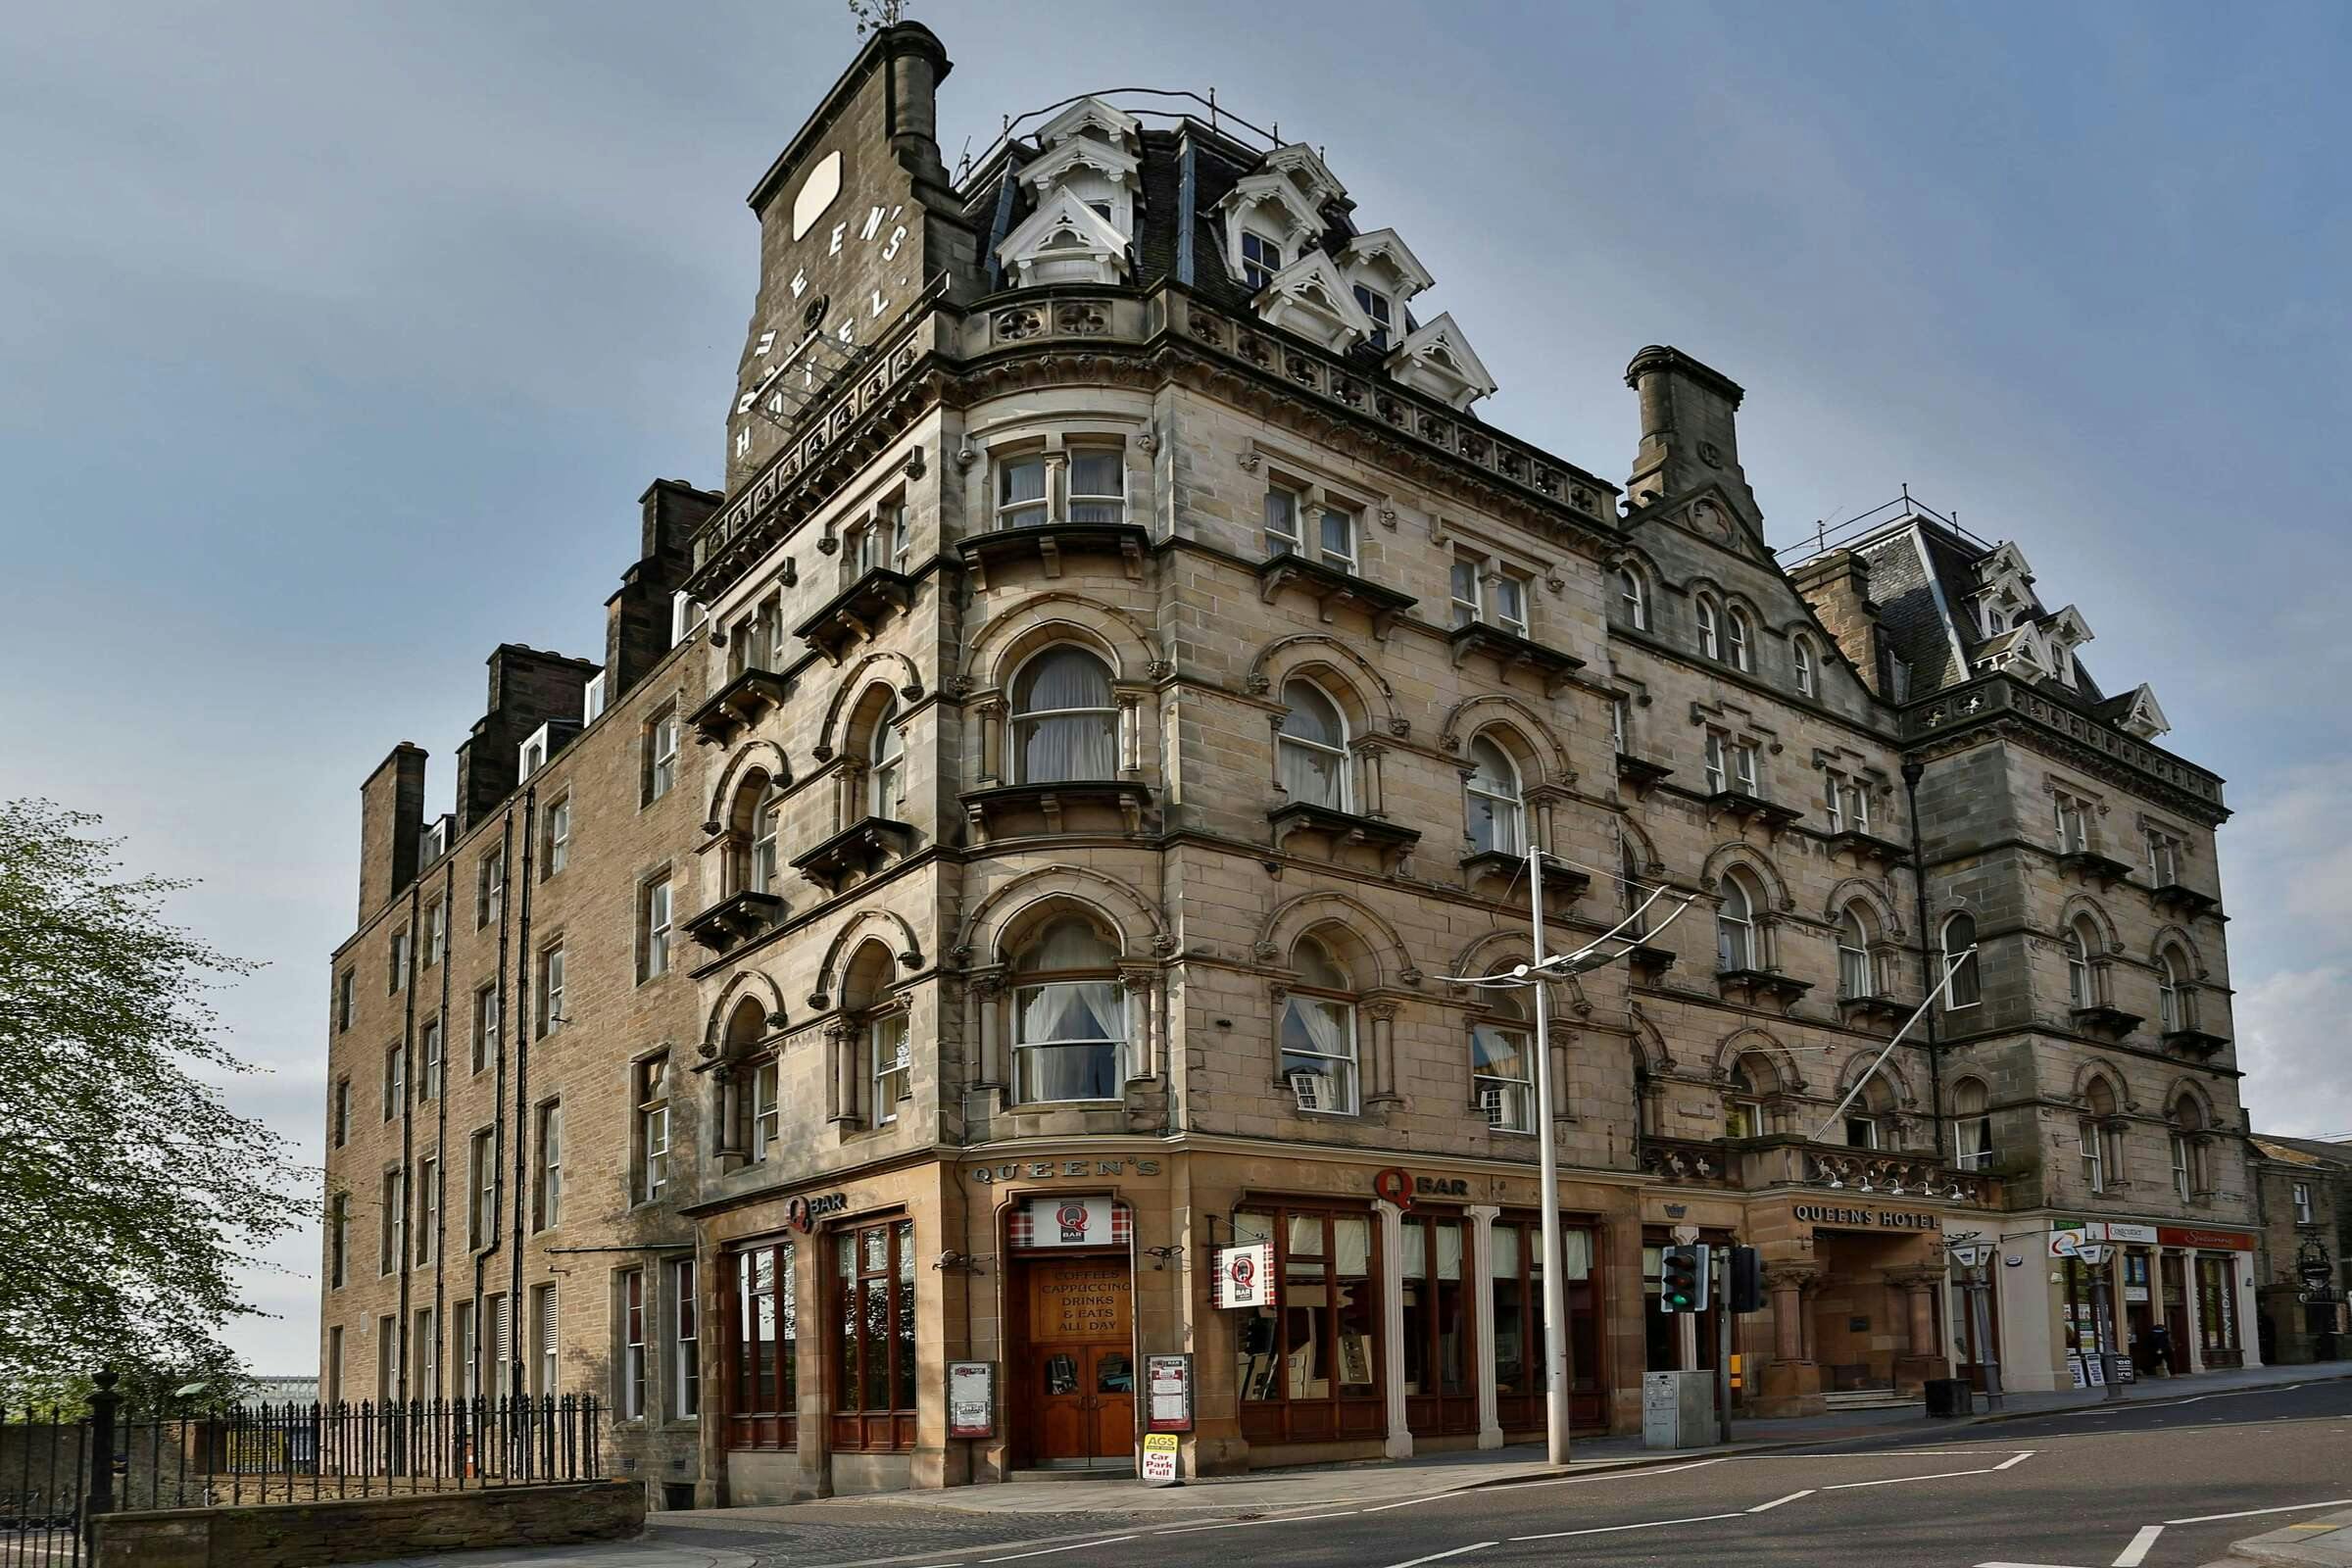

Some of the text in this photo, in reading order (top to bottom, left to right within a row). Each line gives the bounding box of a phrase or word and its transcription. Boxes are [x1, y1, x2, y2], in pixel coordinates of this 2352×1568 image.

[971, 1154, 1161, 1184] QUEEN'S
[1374, 1168, 1414, 1209] Q
[1416, 1176, 1468, 1196] BAR
[785, 1193, 846, 1233] Q BAR
[1055, 1205, 1091, 1232] Q
[1794, 1204, 1942, 1229] QUEENS HOTEL
[1232, 1257, 1254, 1289] Q
[1042, 1282, 1131, 1294] CAPPUCCINO
[1062, 1296, 1114, 1306] DRINKS
[1058, 1321, 1116, 1331] ALL DAY
[1078, 1308, 1114, 1318] EATS
